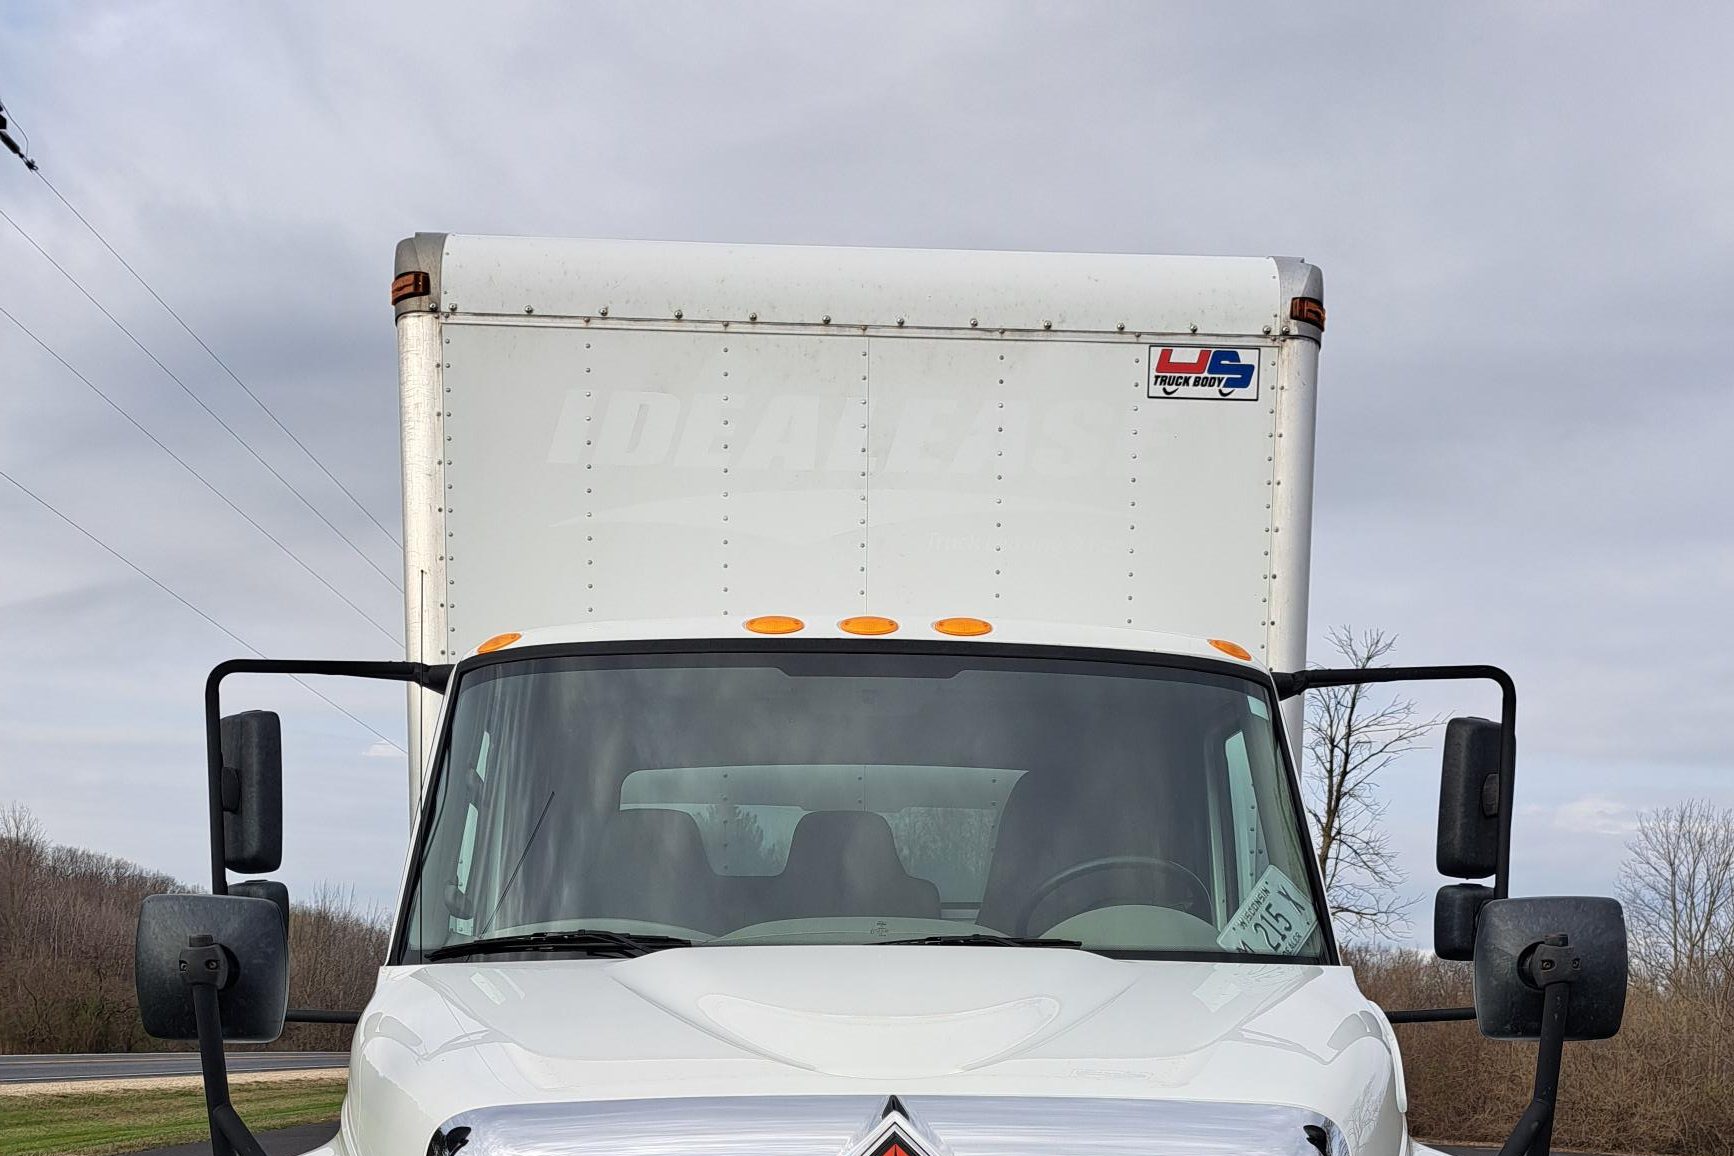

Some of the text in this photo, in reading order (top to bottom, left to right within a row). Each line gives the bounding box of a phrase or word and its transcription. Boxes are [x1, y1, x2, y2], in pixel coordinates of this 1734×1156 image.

[1153, 375, 1226, 388] TRUCK BODY
[1155, 348, 1255, 388] US
[1239, 886, 1271, 930] WISCONSIN
[1253, 902, 1293, 952] 215
[1276, 884, 1306, 915] X
